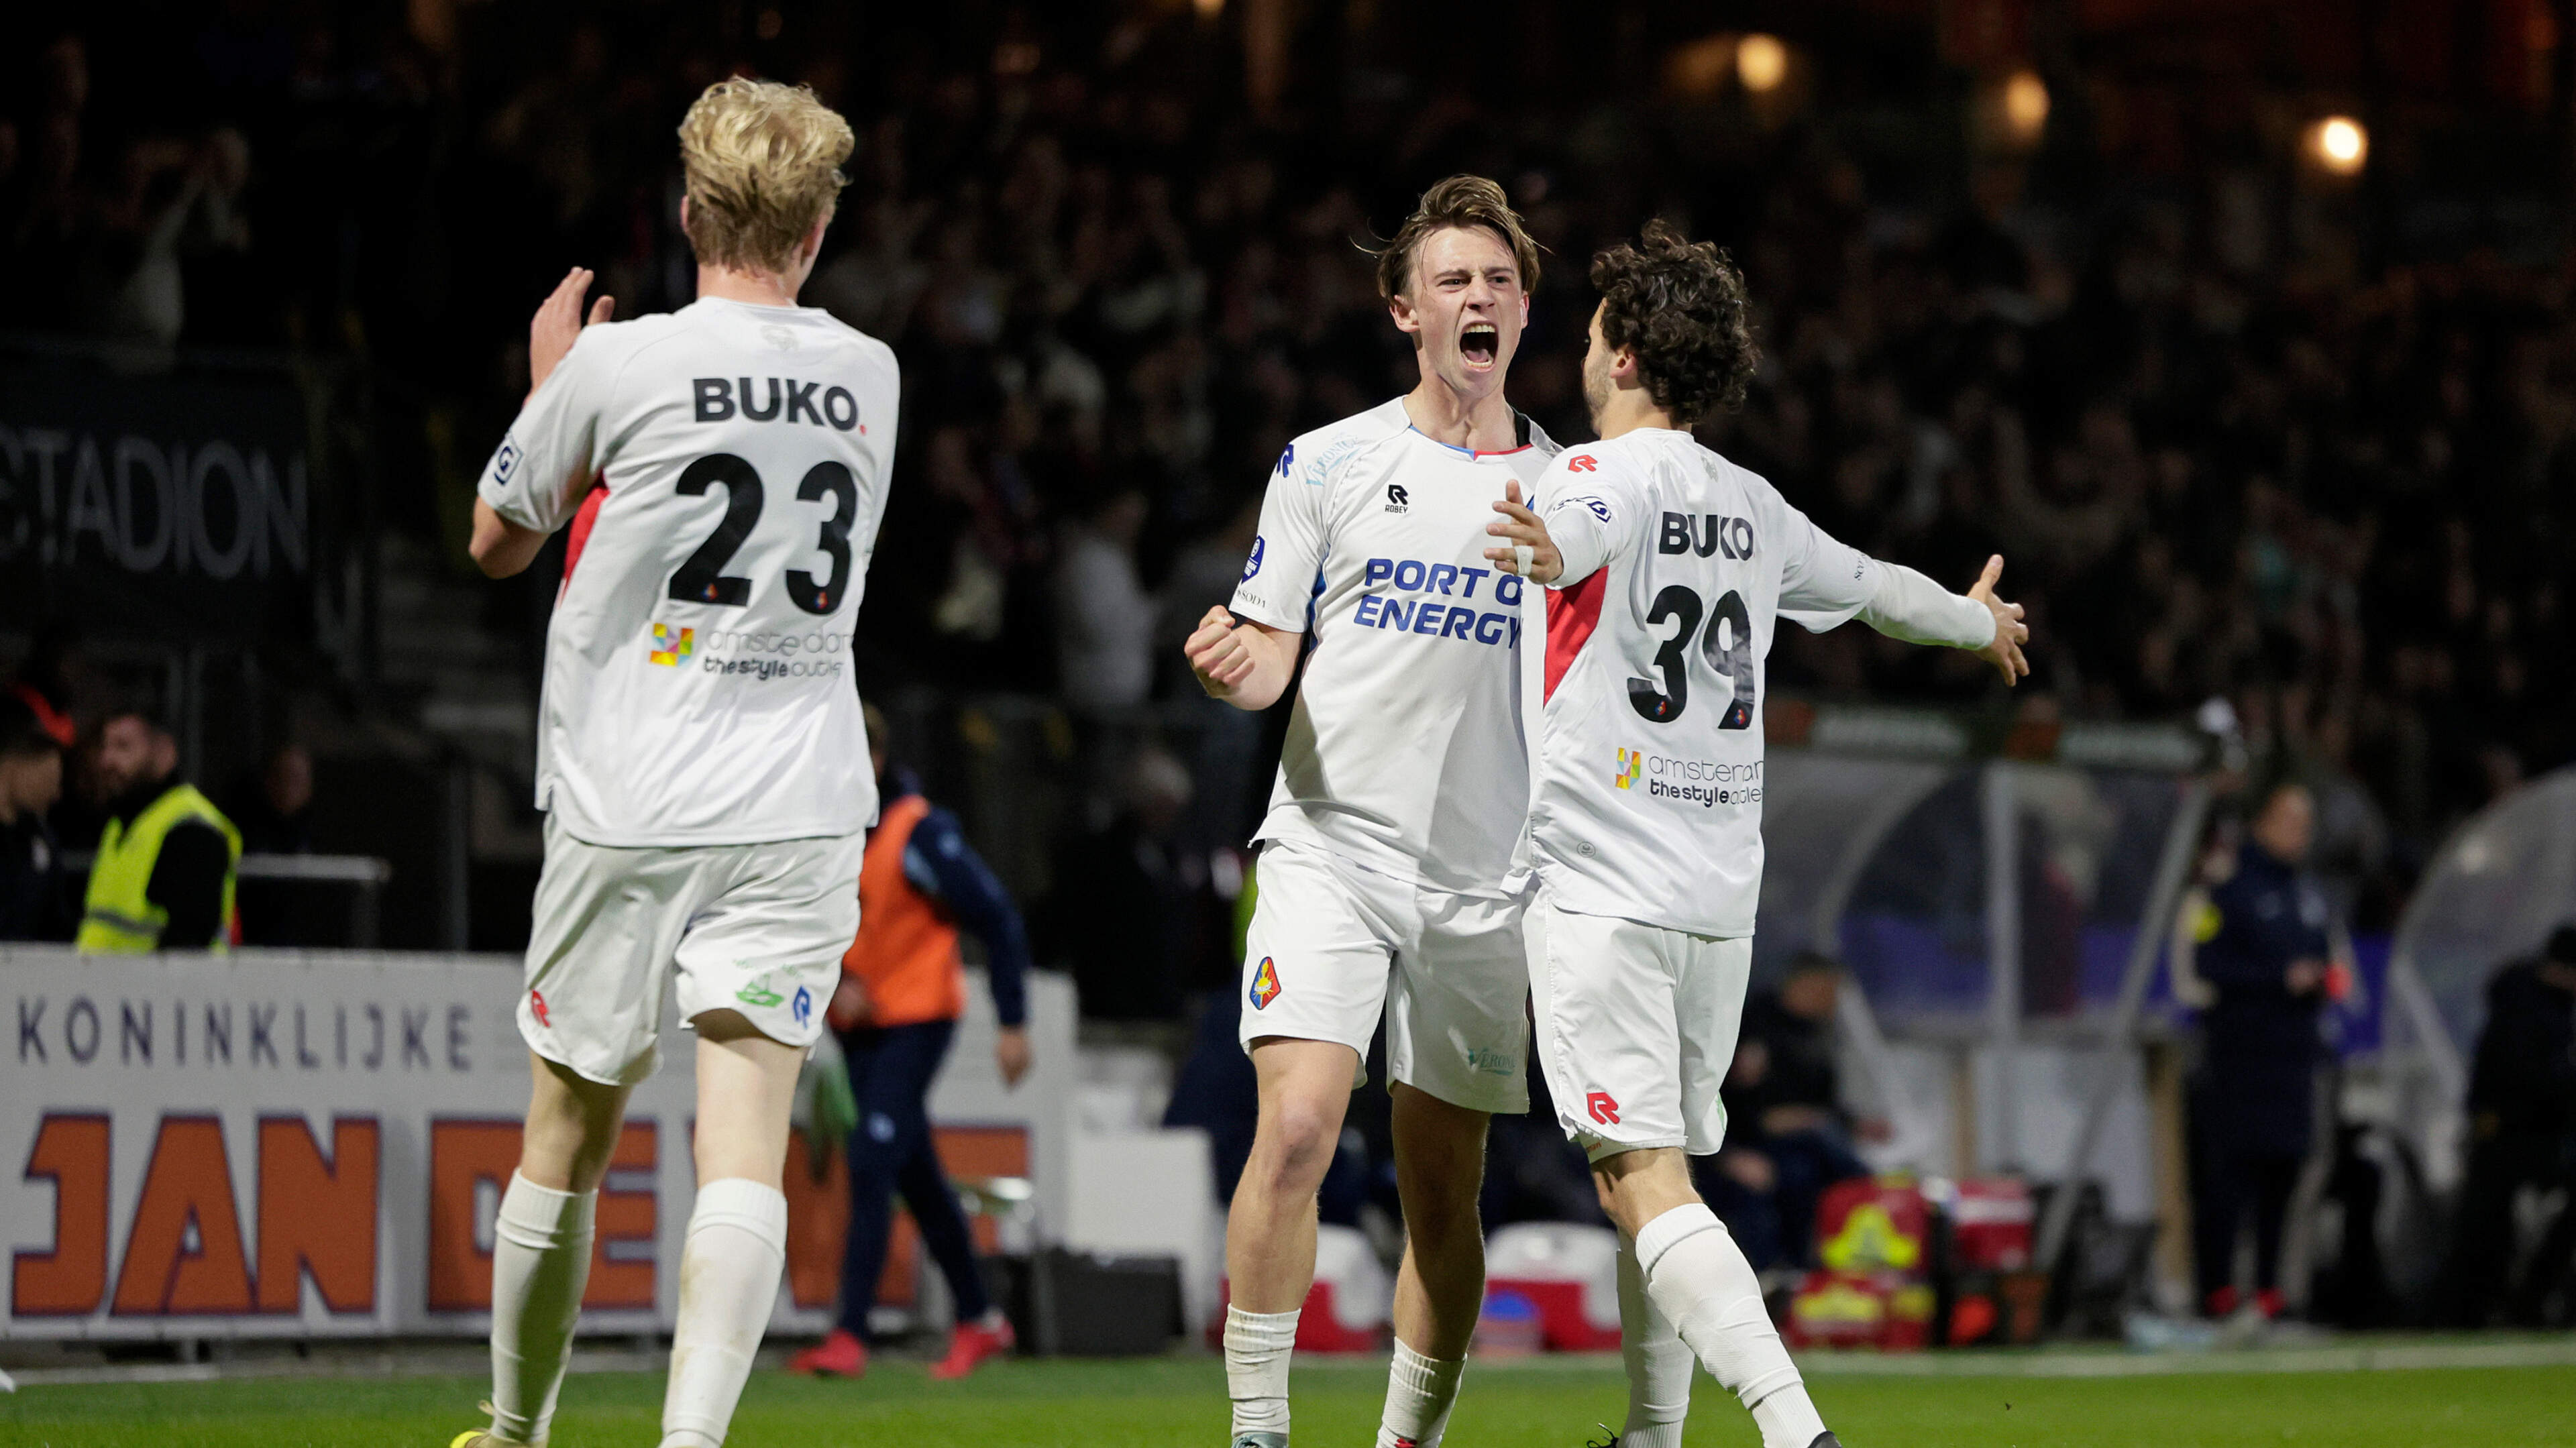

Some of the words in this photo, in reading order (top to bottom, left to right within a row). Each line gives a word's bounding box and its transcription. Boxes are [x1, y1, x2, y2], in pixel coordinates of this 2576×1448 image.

[667, 453, 858, 616] 23
[1385, 504, 1409, 514] ROBEY
[1364, 558, 1490, 598] PORT
[1627, 584, 1755, 730] 39
[18, 994, 473, 1072] KONINKLIJKE
[11, 1108, 380, 1319] JAN
